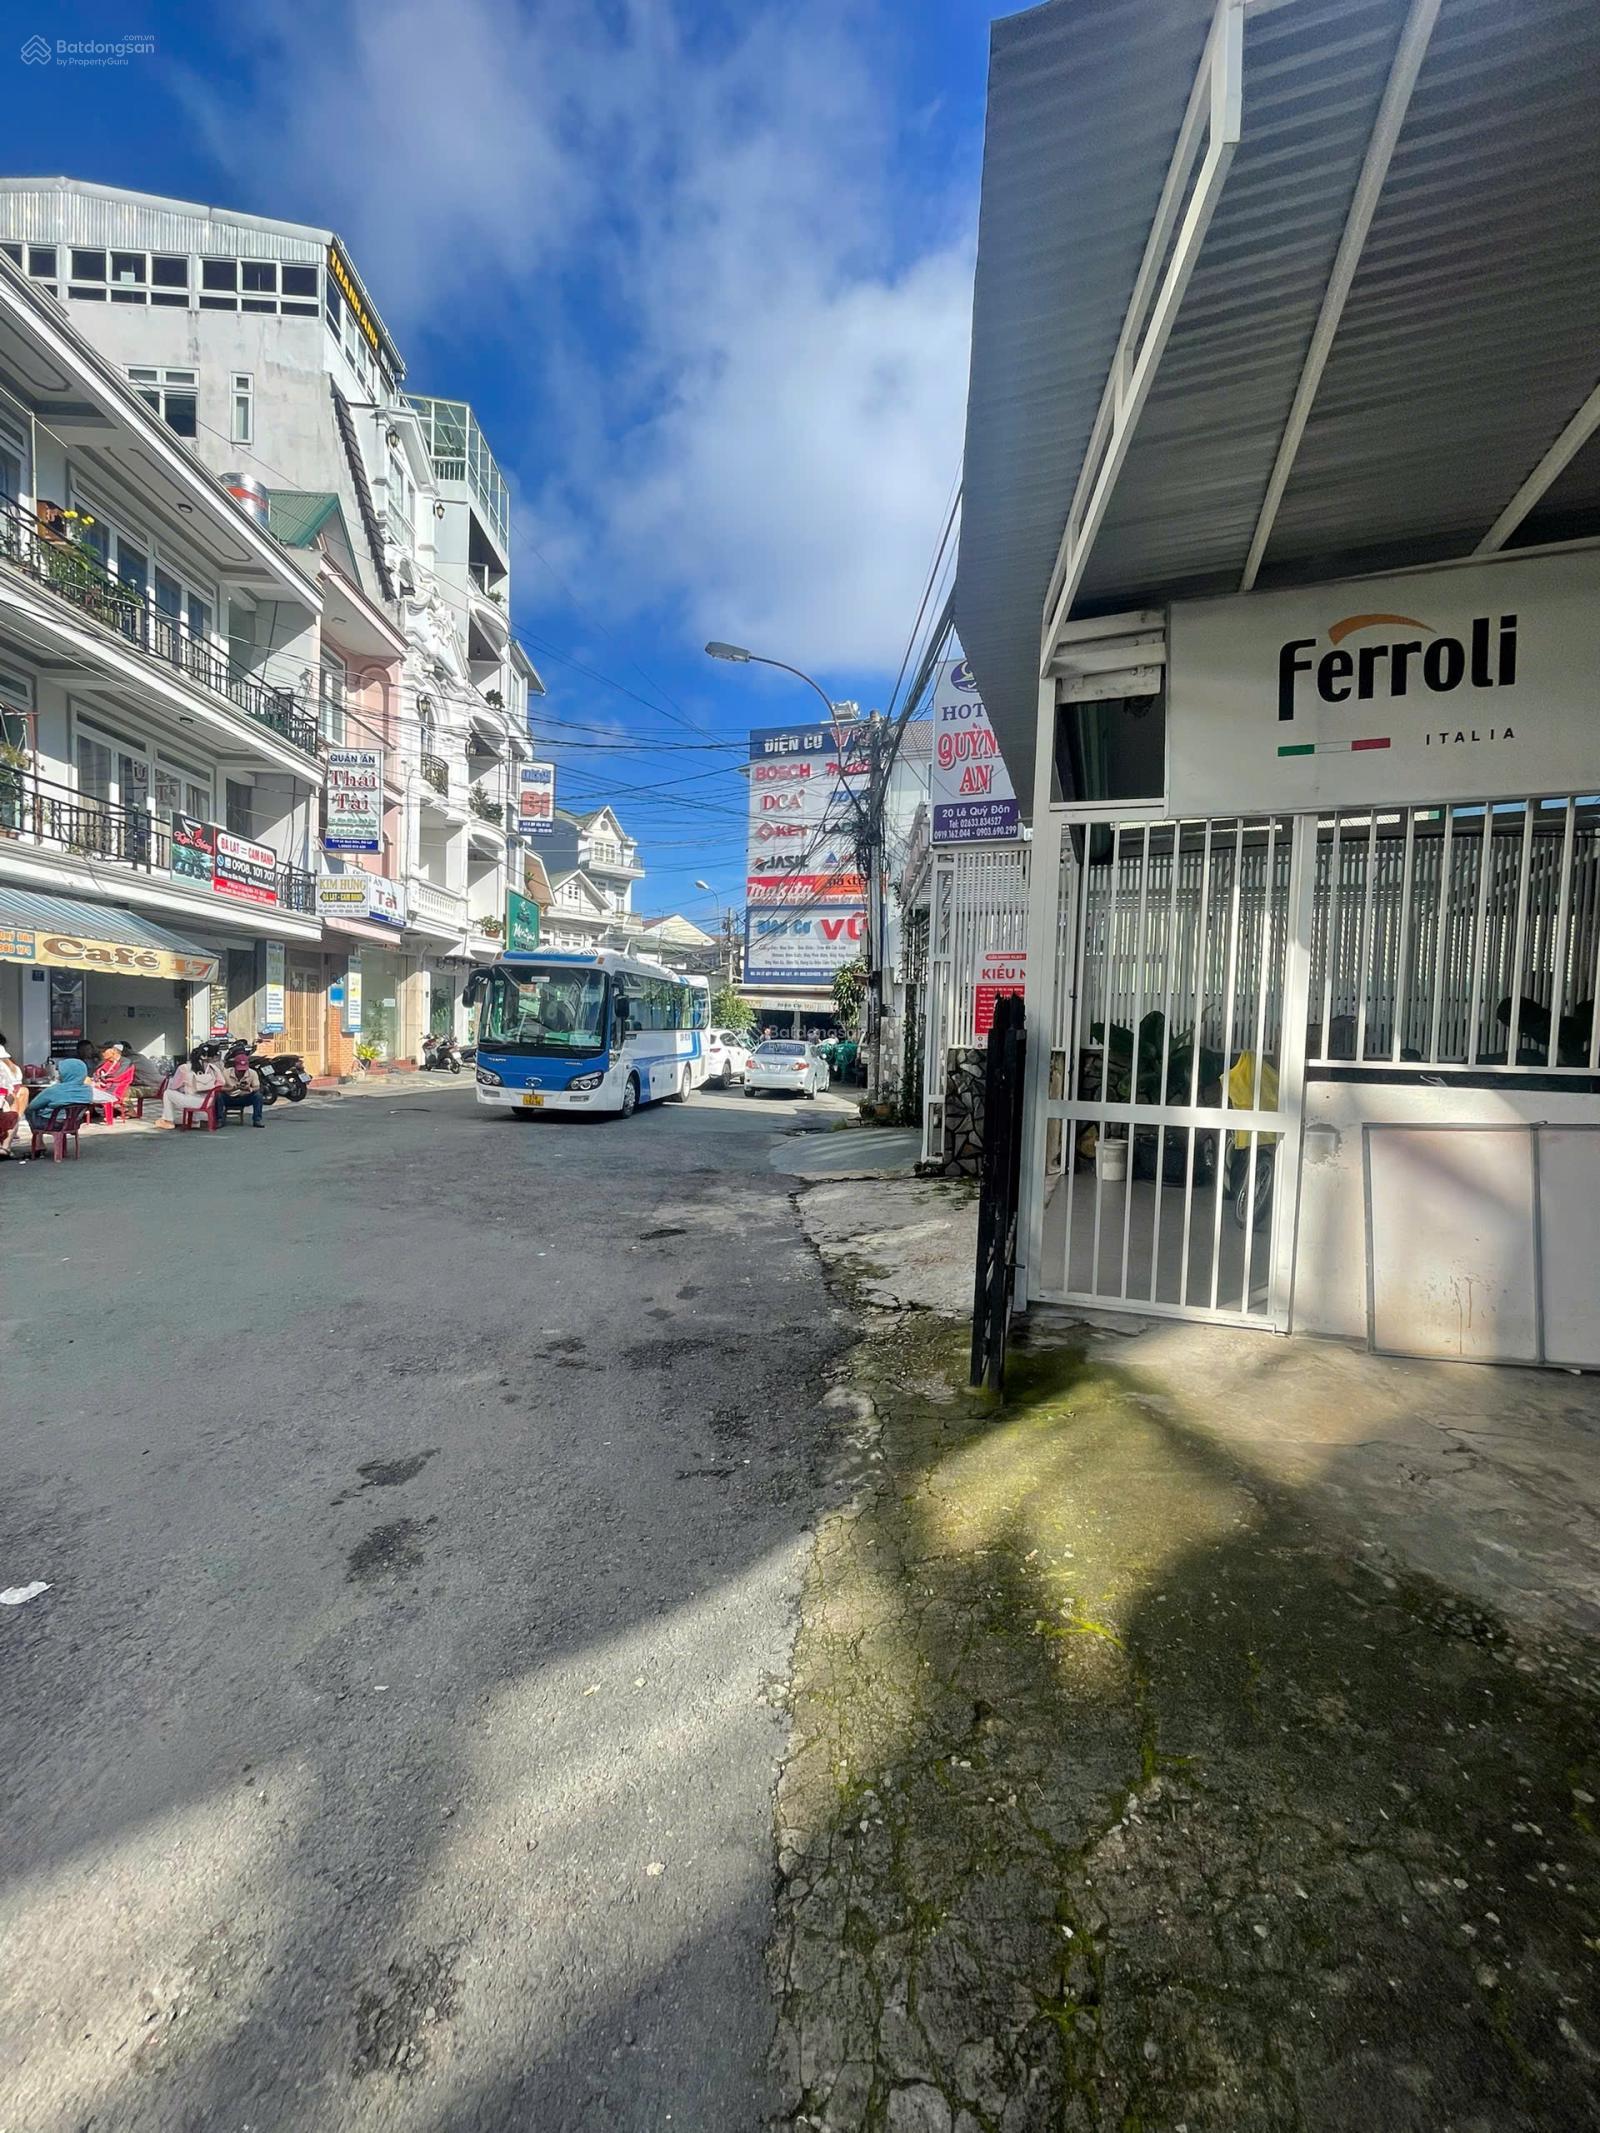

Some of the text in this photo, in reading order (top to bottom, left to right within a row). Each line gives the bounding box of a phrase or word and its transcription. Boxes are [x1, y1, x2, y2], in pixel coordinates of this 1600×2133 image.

[330, 248, 379, 350] THANH ANH
[942, 703, 985, 721] HOT
[1426, 728, 1515, 745] ITALIA
[938, 722, 1001, 770] QUỲN
[329, 752, 358, 764] QUÁN
[329, 769, 378, 789] Thái
[756, 763, 811, 781] BOSCH
[959, 765, 993, 796] AN
[335, 792, 369, 811] Tài
[942, 808, 954, 818] 20
[956, 806, 967, 817] Lê
[970, 805, 988, 817] Quý
[960, 816, 1002, 828] 02633.834527
[248, 847, 260, 860] CAM
[232, 859, 252, 875] 0908.
[253, 867, 263, 878] 101
[264, 869, 275, 882] 707
[319, 878, 337, 890] KIM
[43, 938, 160, 968] Café
